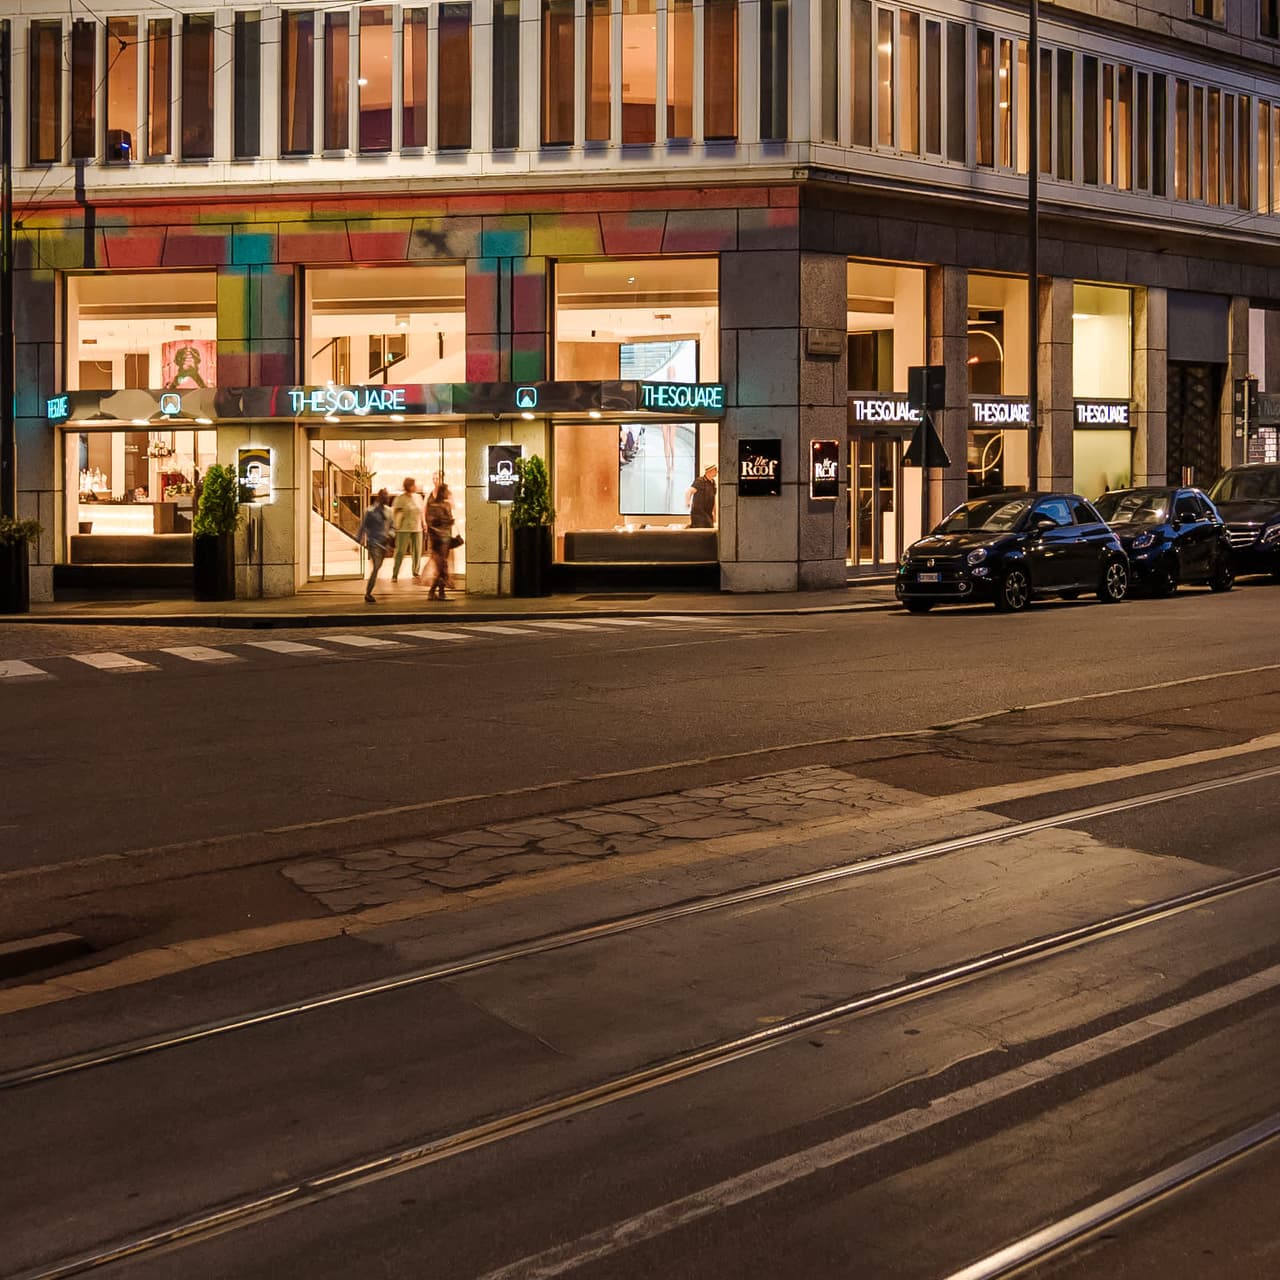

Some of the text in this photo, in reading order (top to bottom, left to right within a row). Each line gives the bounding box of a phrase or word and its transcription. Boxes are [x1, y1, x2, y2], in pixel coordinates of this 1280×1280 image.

[288, 389, 406, 412] THESQUARE
[642, 385, 722, 407] THESQUARE
[972, 403, 1030, 423] THESQUARE
[1076, 405, 1128, 423] THESQUARE
[741, 460, 779, 476] Roof
